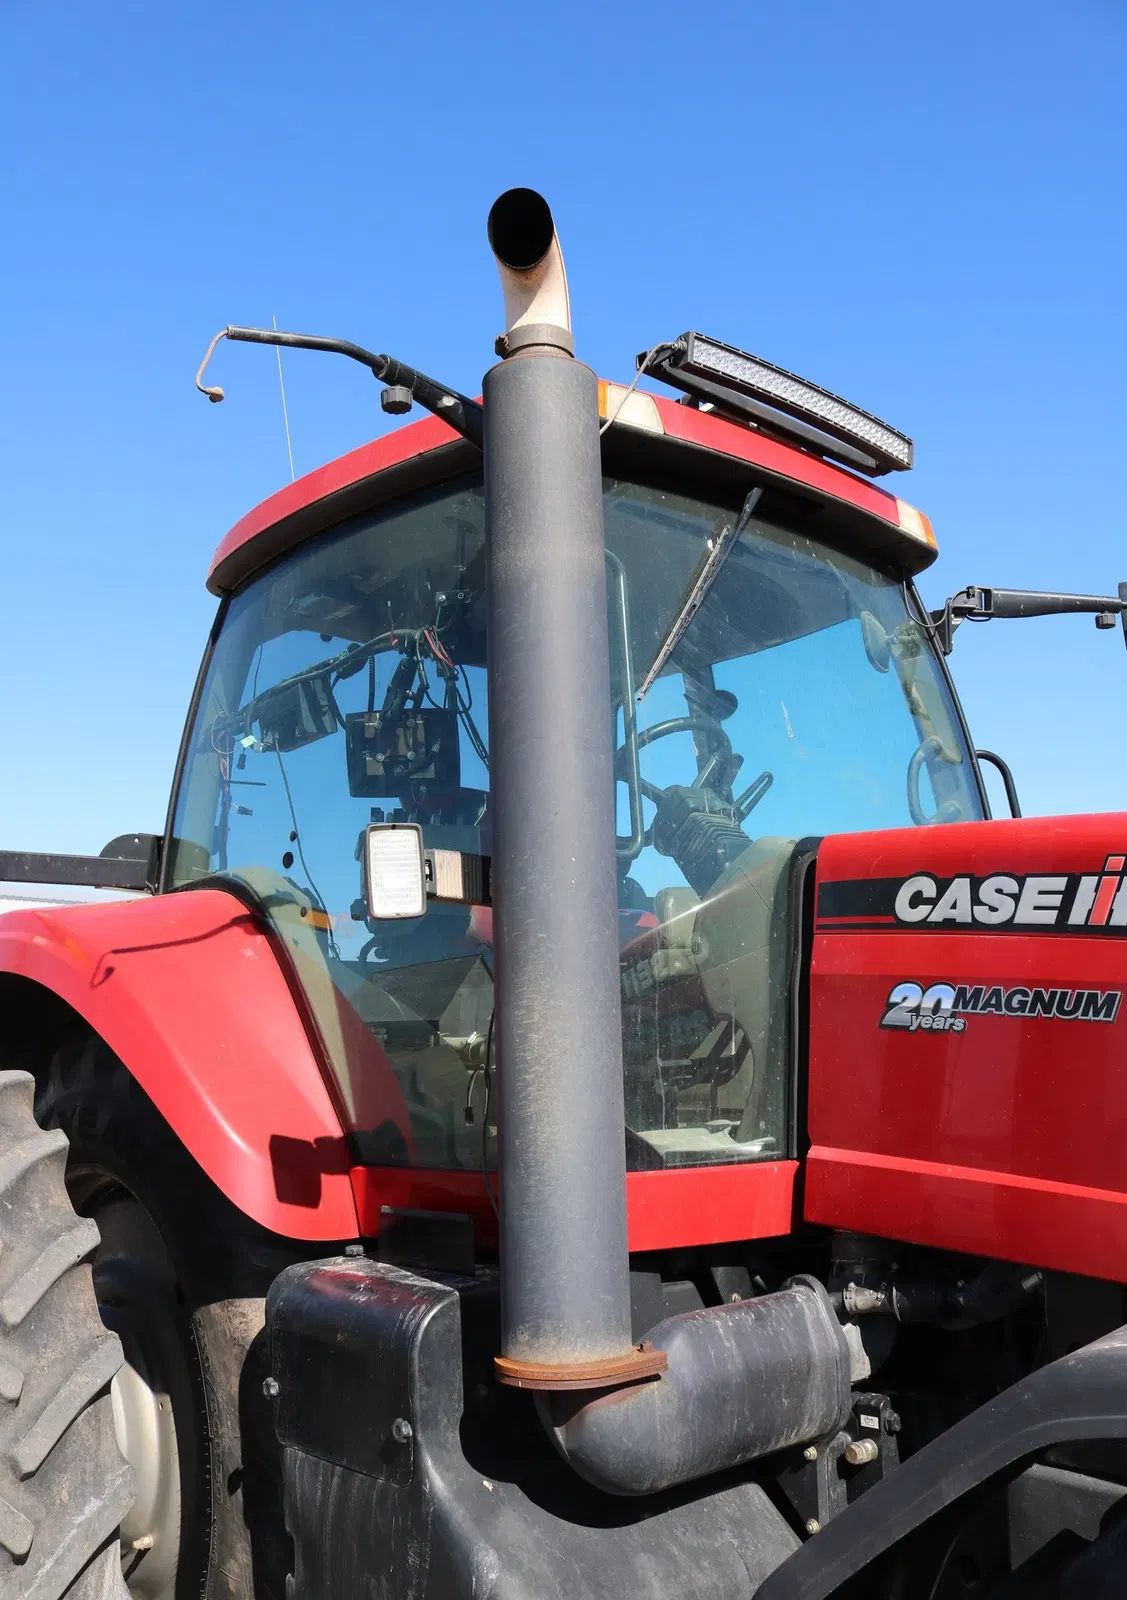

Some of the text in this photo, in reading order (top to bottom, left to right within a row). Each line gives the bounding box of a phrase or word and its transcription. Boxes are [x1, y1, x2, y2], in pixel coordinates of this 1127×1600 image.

[895, 876, 1068, 925] CASE
[881, 983, 957, 1027] 20
[909, 1015, 965, 1031] years
[951, 984, 1122, 1022] MAGNUM
